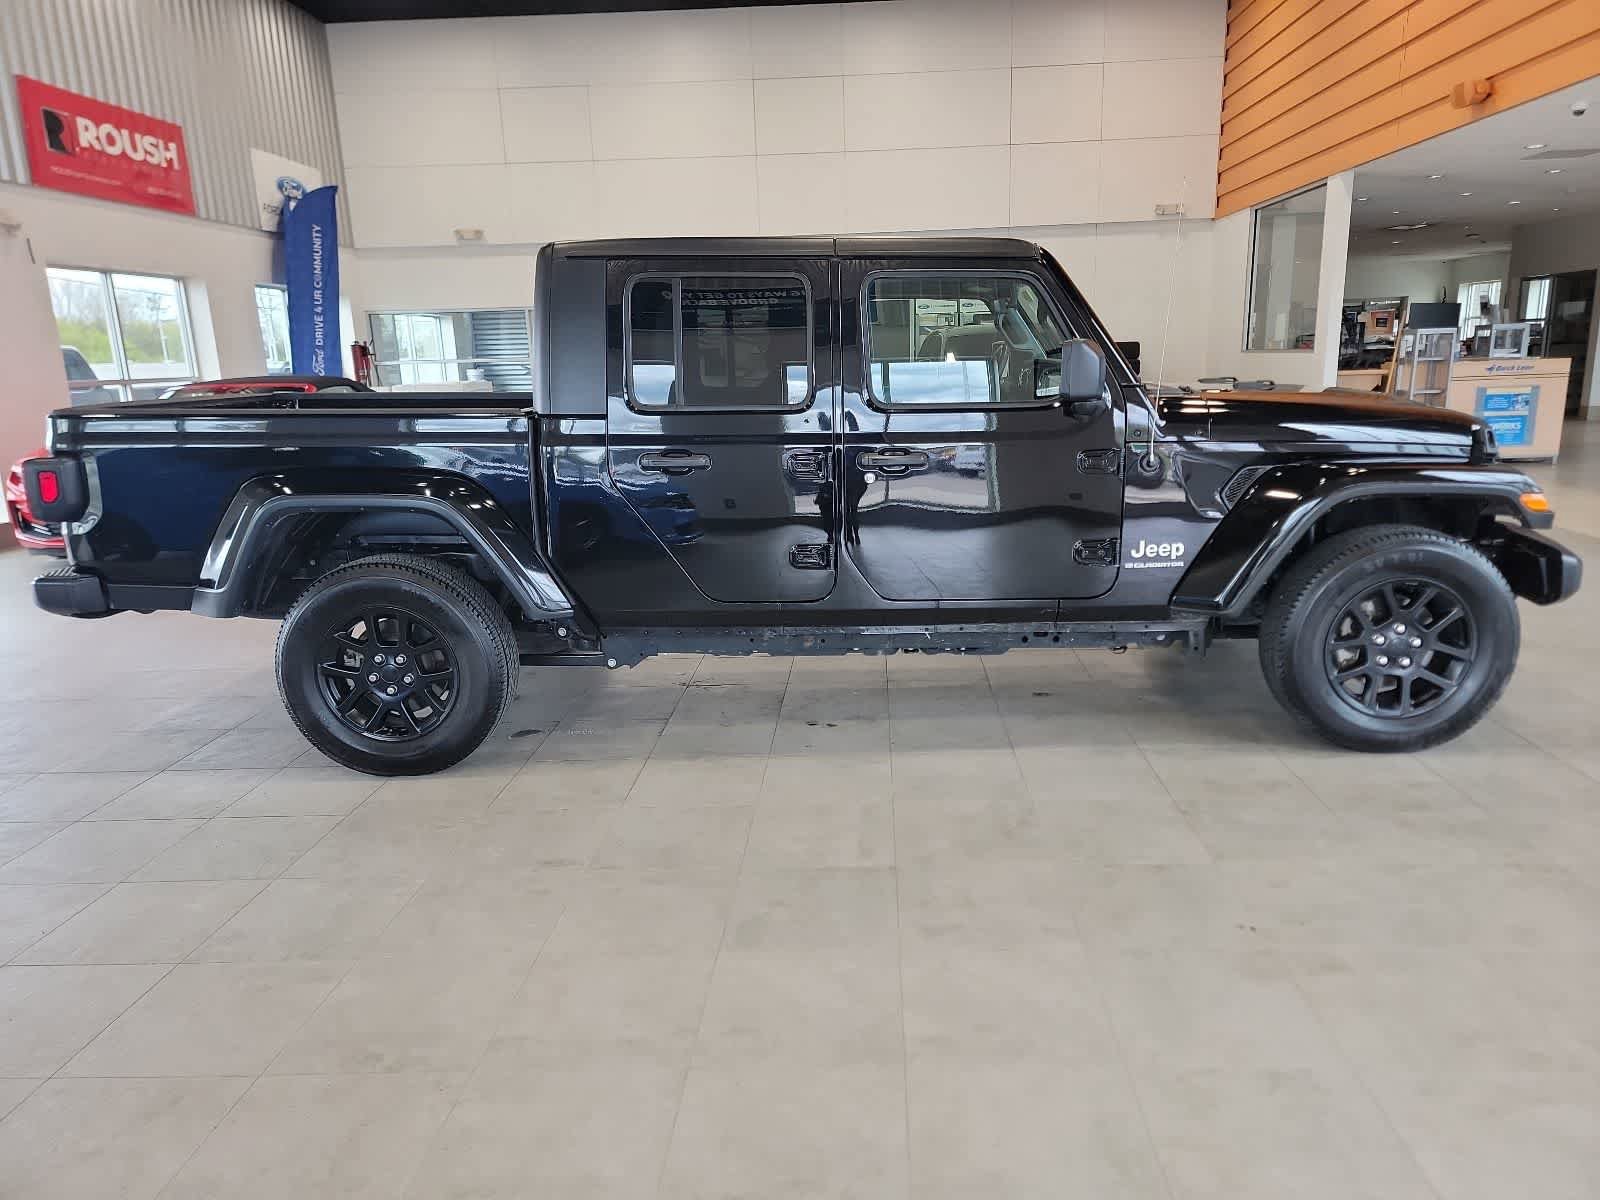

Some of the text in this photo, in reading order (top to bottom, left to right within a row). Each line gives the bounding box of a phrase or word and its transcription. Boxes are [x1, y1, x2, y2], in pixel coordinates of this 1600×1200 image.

[75, 116, 180, 170] ROUSH
[311, 224, 323, 288] COMMUNITY
[313, 290, 323, 305] UR
[314, 315, 324, 346] DRIVE
[312, 348, 325, 376] Ford
[1131, 539, 1185, 560] Jeep
